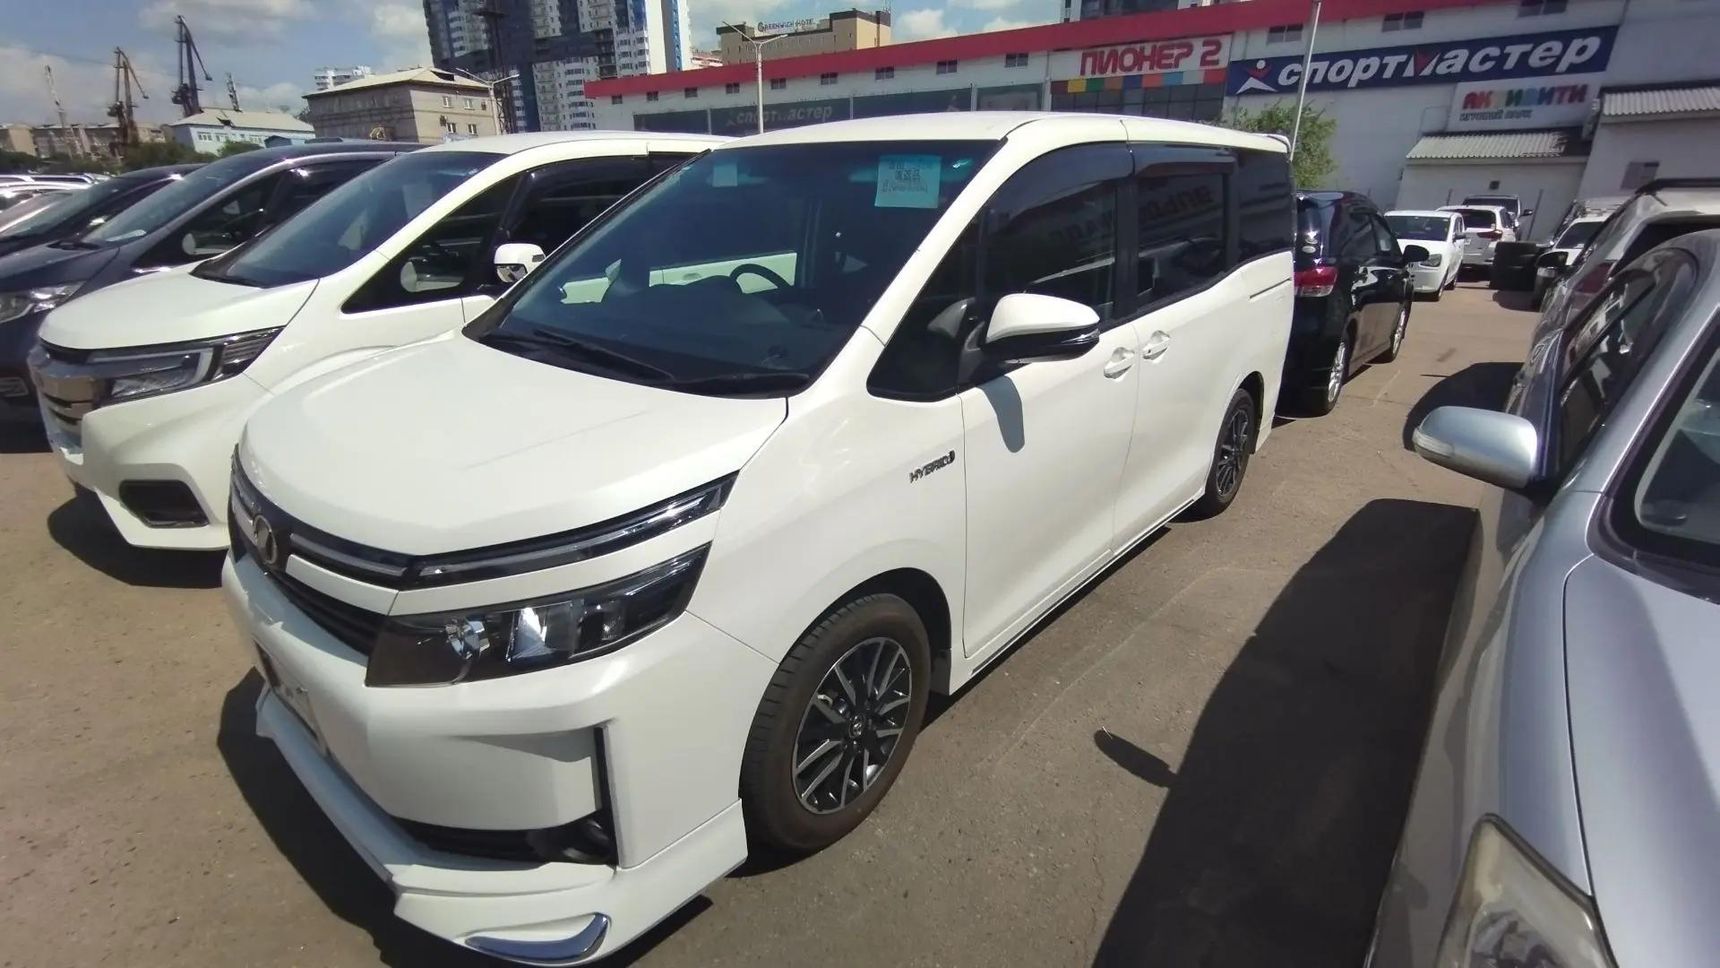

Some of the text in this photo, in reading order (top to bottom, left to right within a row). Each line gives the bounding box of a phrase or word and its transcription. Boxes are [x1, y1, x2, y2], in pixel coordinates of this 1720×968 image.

[1080, 38, 1222, 76] ПИОНЕР 2
[1277, 35, 1602, 88] спортмастер
[909, 450, 955, 484] HYBRID
